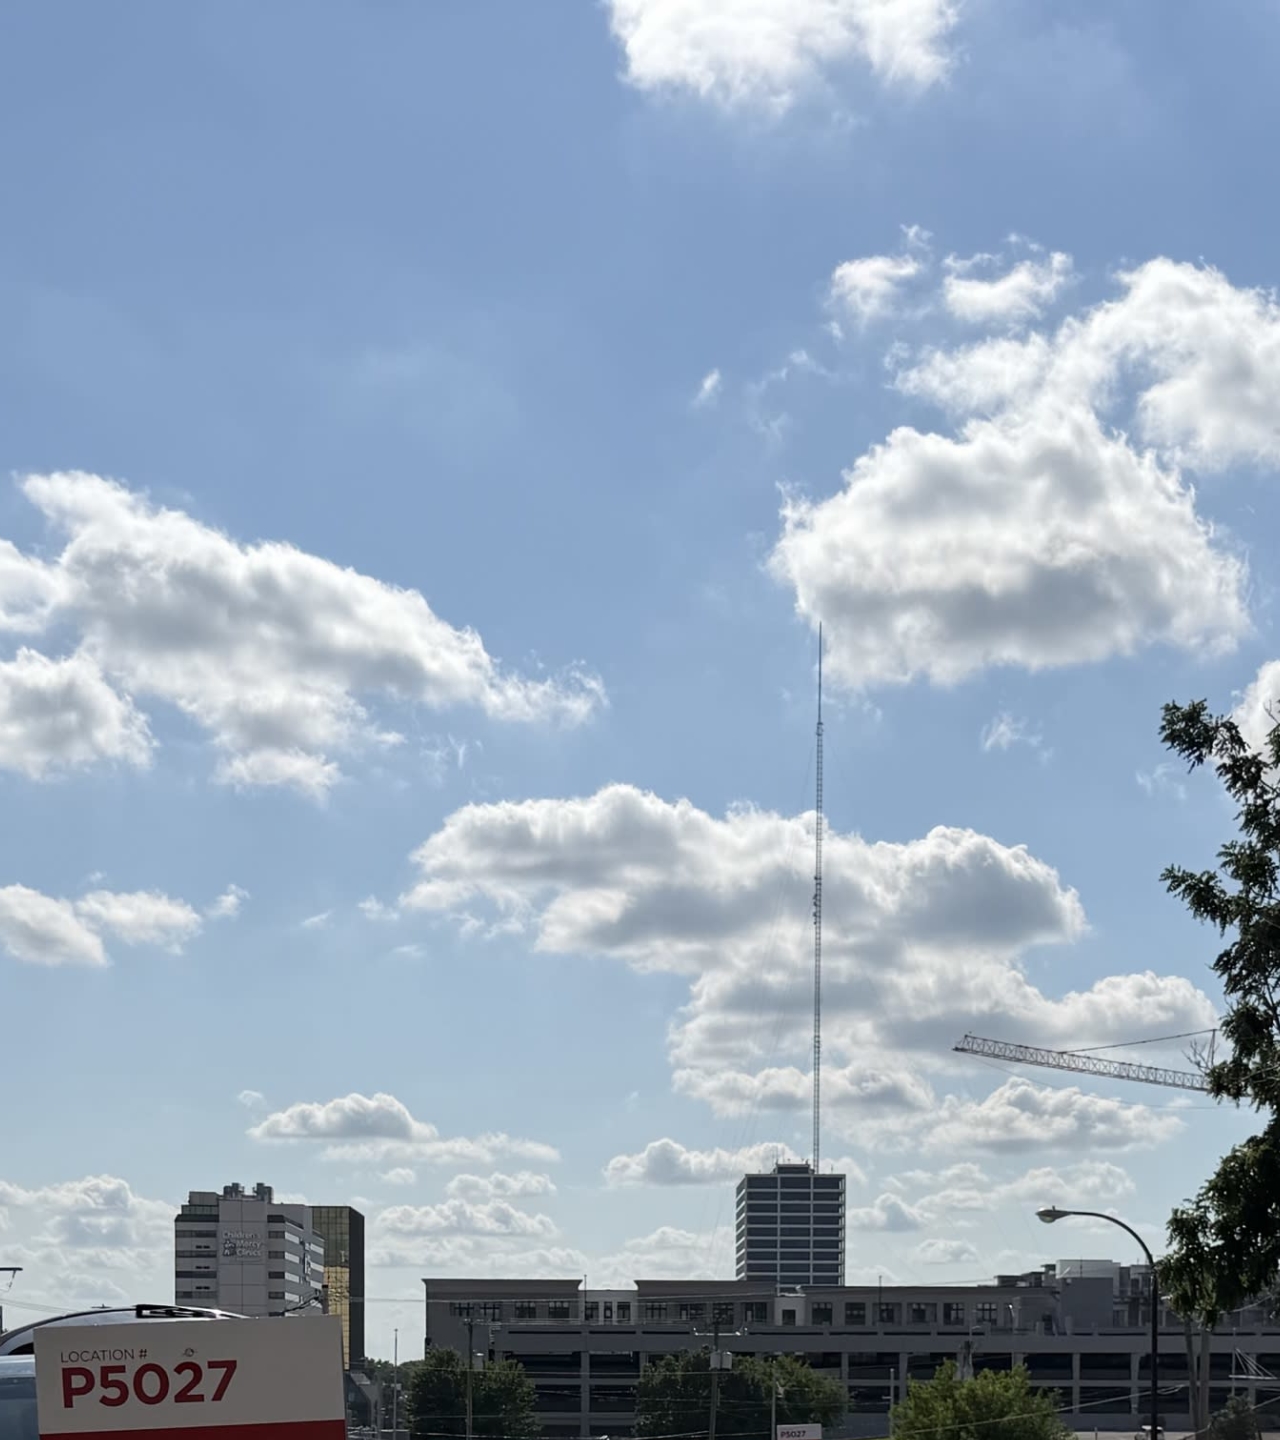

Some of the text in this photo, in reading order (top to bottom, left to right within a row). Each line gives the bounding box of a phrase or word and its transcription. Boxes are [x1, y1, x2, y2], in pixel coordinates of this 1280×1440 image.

[60, 1349, 148, 1363] LOCATION #
[61, 1360, 238, 1409] P5027
